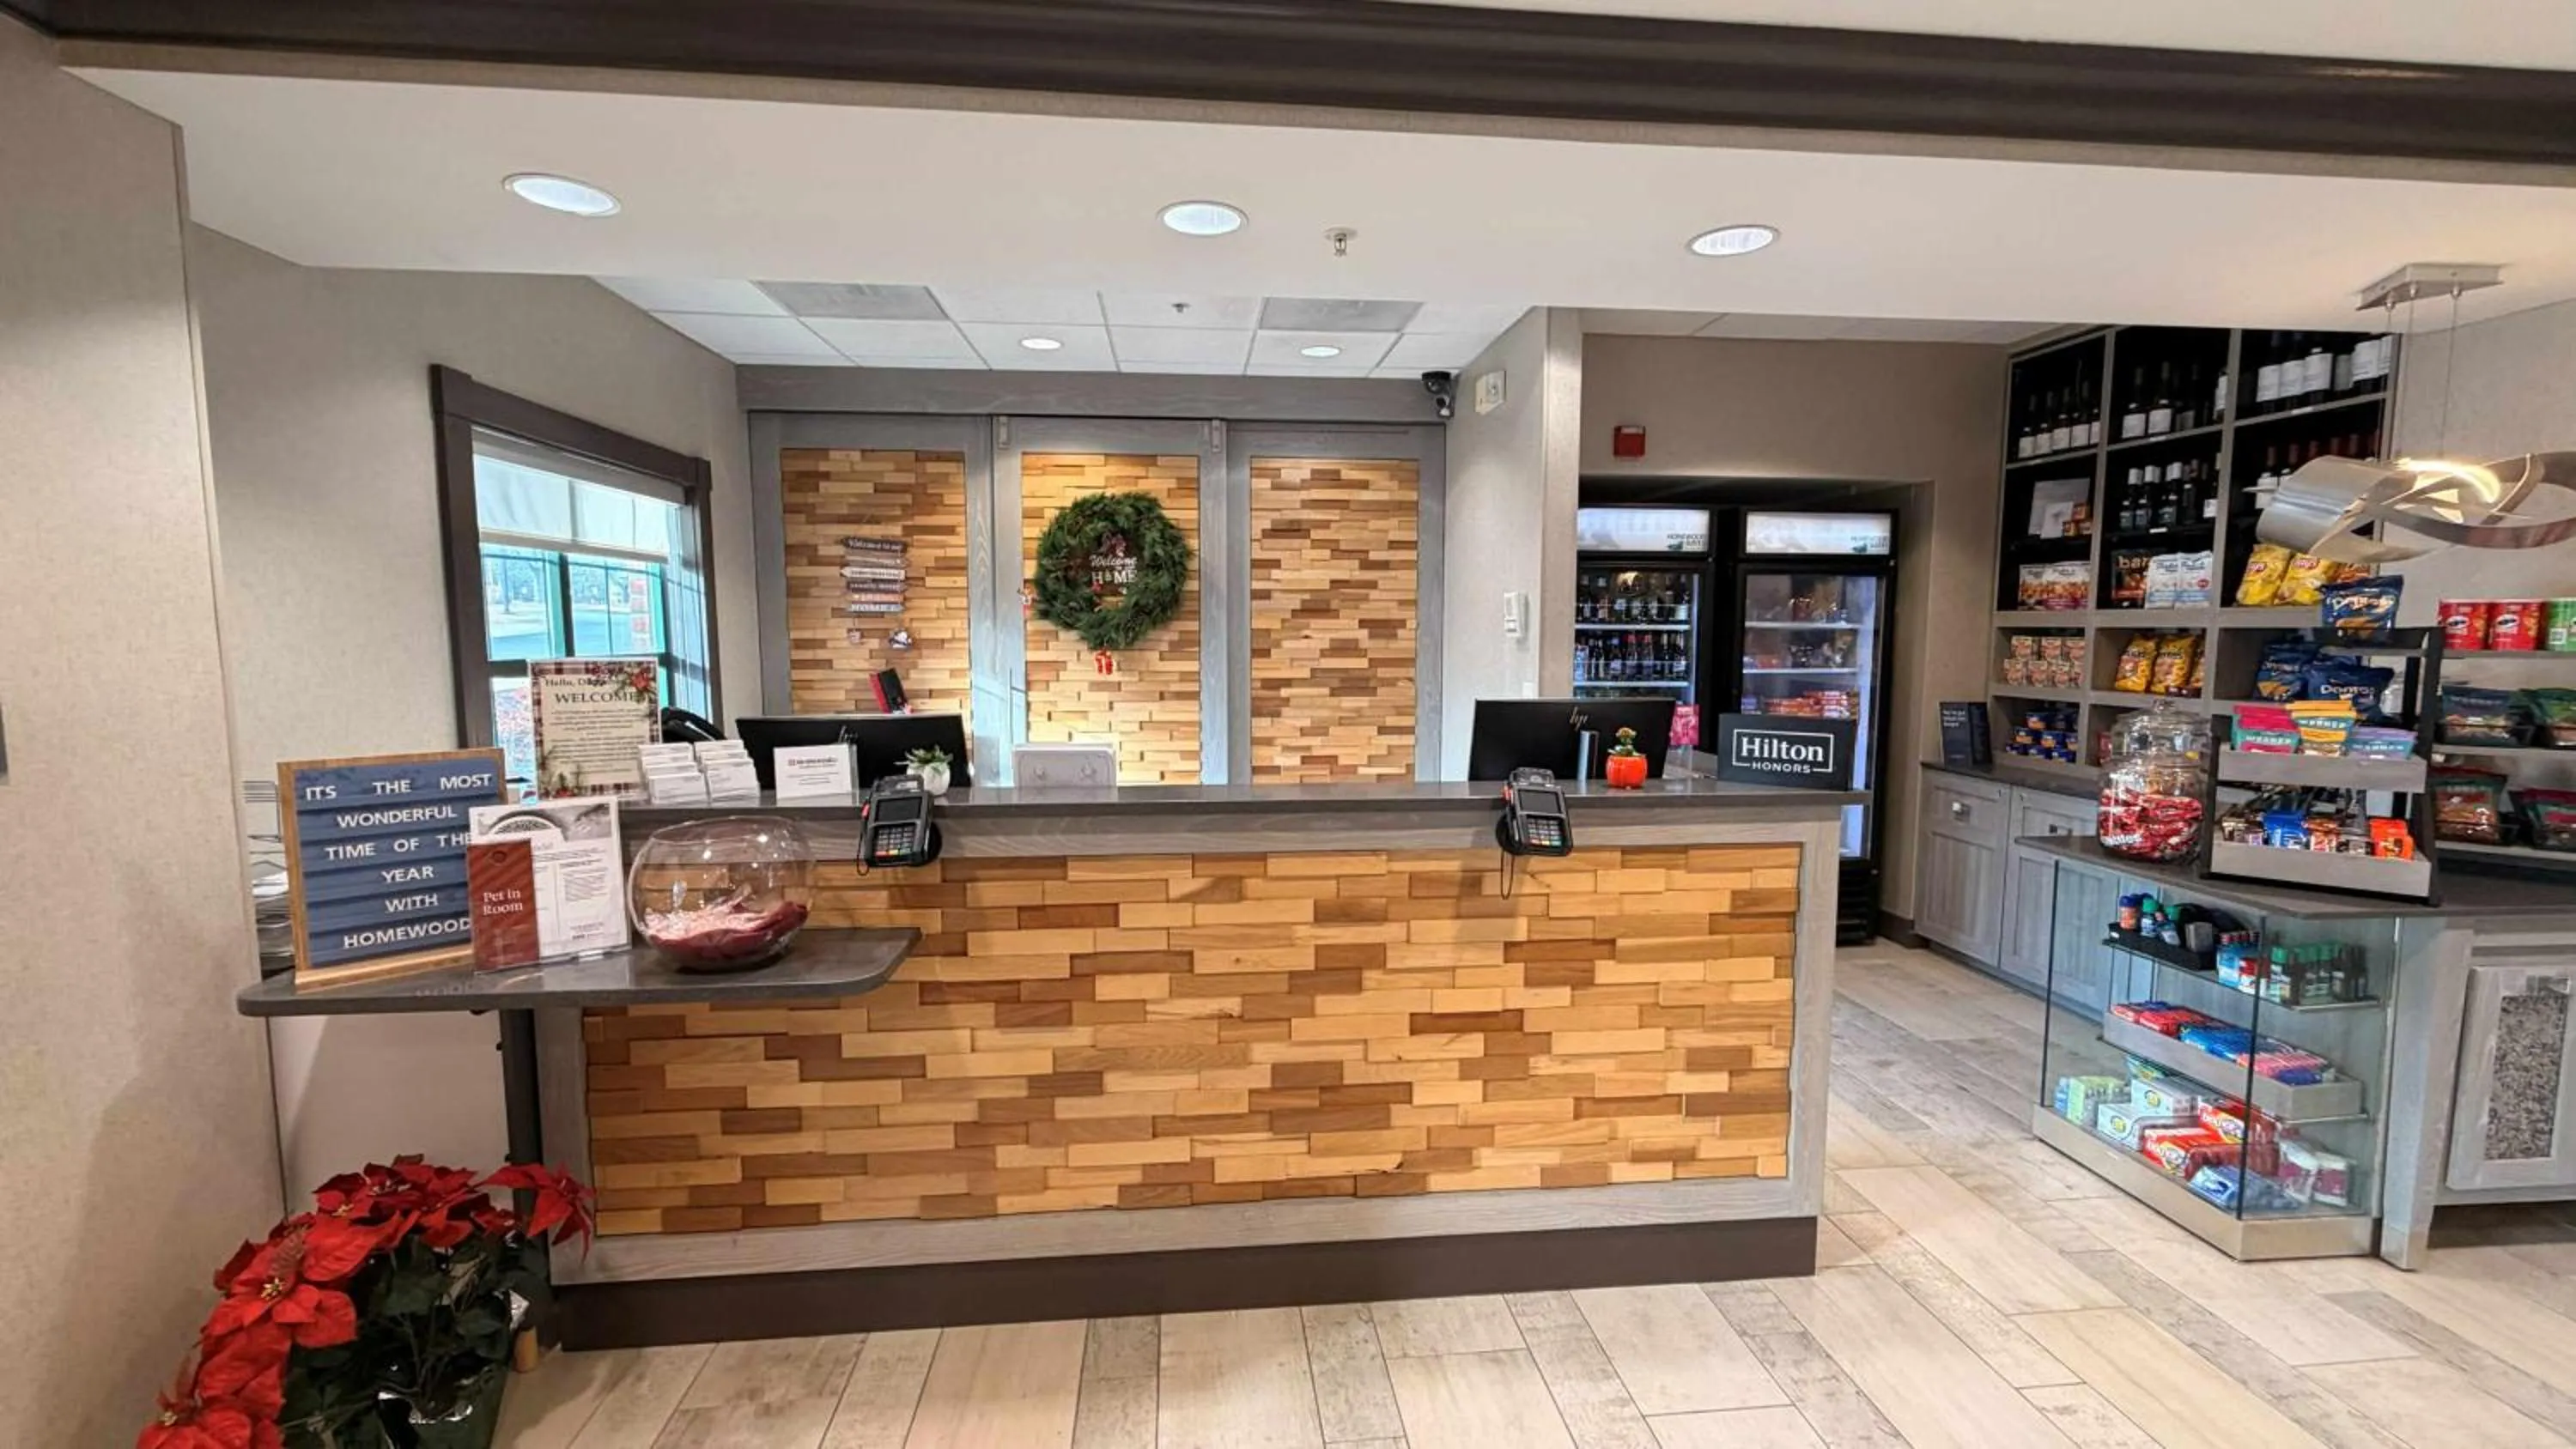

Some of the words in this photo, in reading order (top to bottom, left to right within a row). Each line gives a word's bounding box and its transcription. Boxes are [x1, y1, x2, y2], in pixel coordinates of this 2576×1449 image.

[1089, 555, 1138, 567] Welcome
[555, 692, 639, 703] WELCOME
[1741, 737, 1825, 762] Hilton
[1752, 761, 1811, 773] HONORS
[305, 785, 337, 801] ITS
[373, 779, 411, 795] THE
[440, 773, 492, 791] MOST
[337, 805, 457, 828] WONDERFUL
[325, 842, 376, 861] TIME
[393, 838, 420, 852] OF
[436, 832, 471, 848] THE
[381, 865, 434, 883] YEAR
[385, 894, 439, 913] WITH
[483, 891, 504, 903] Pet
[507, 889, 521, 900] in
[483, 902, 524, 916] Room
[343, 917, 471, 949] HOMEWOOD
